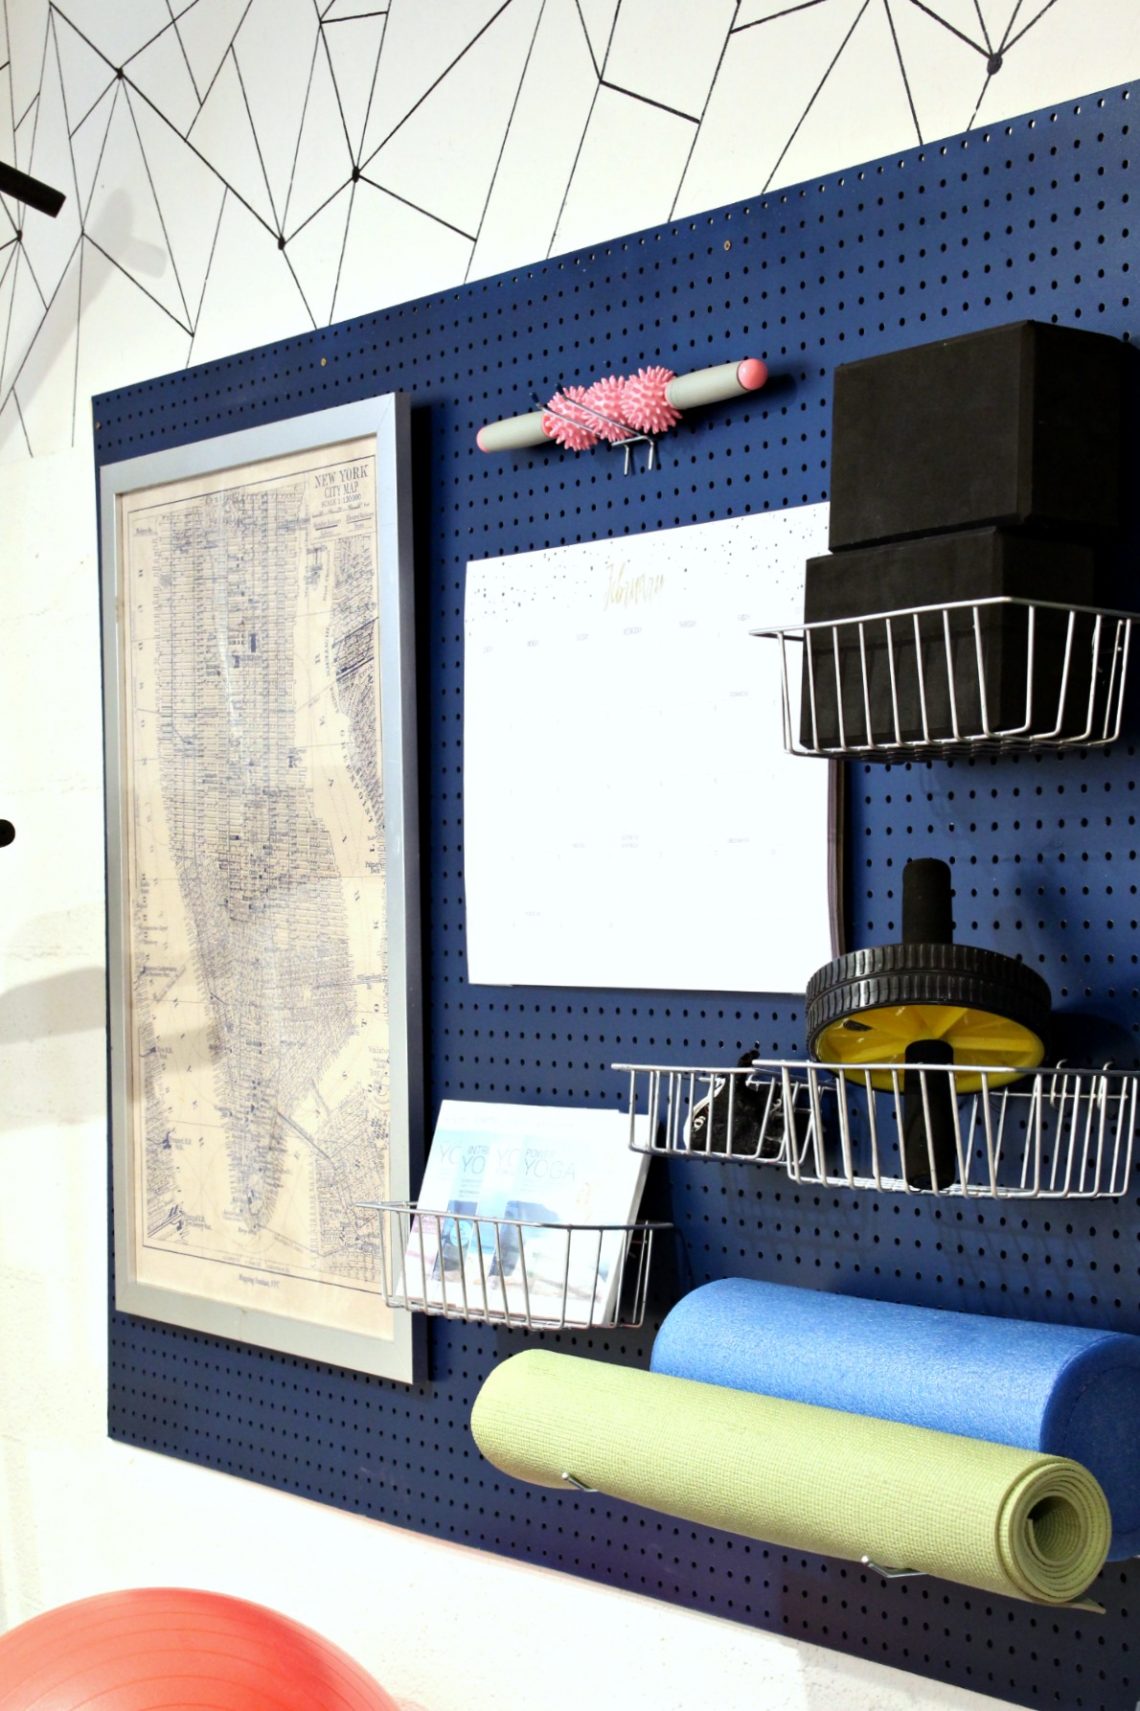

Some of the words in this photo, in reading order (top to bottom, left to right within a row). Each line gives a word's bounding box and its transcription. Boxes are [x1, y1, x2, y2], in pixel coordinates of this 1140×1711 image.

[314, 471, 336, 488] NEW
[340, 464, 368, 482] YORK
[324, 484, 340, 498] CITY
[343, 481, 358, 495] MAP
[462, 1154, 486, 1174] YO
[523, 1156, 577, 1182] YOGA
